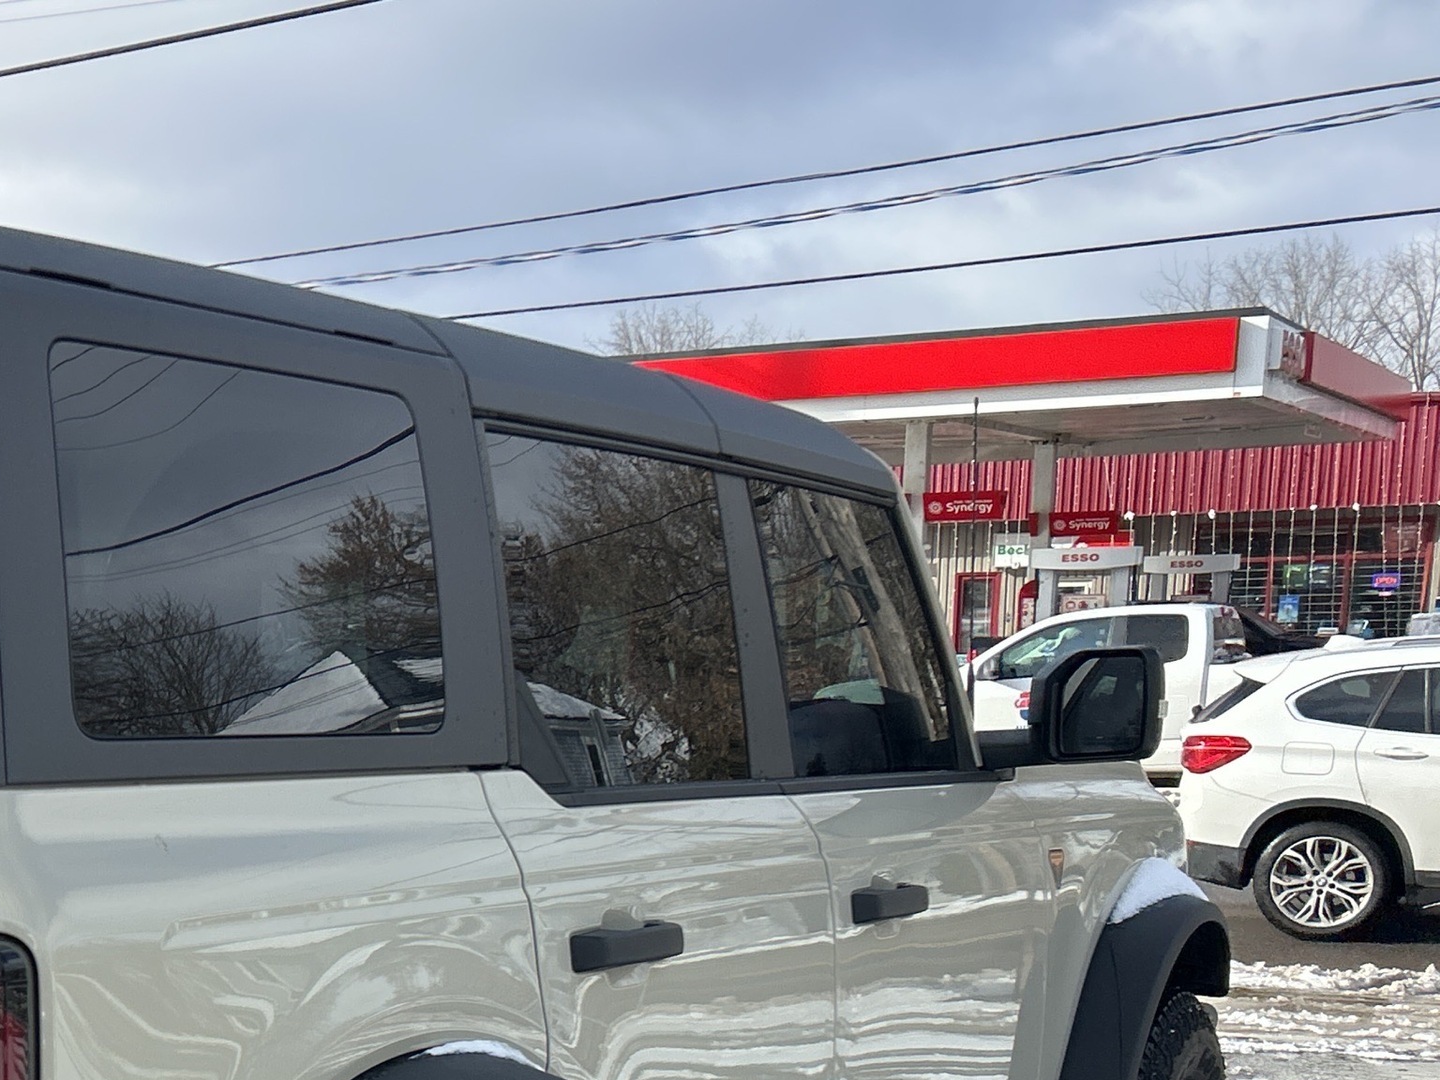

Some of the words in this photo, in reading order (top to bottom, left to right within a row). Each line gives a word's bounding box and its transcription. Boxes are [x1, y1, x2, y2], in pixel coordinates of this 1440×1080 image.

[946, 501, 993, 514] Synergy
[1068, 519, 1110, 530] Synergy
[1061, 553, 1100, 562] ESSO
[1169, 558, 1204, 568] ESSO
